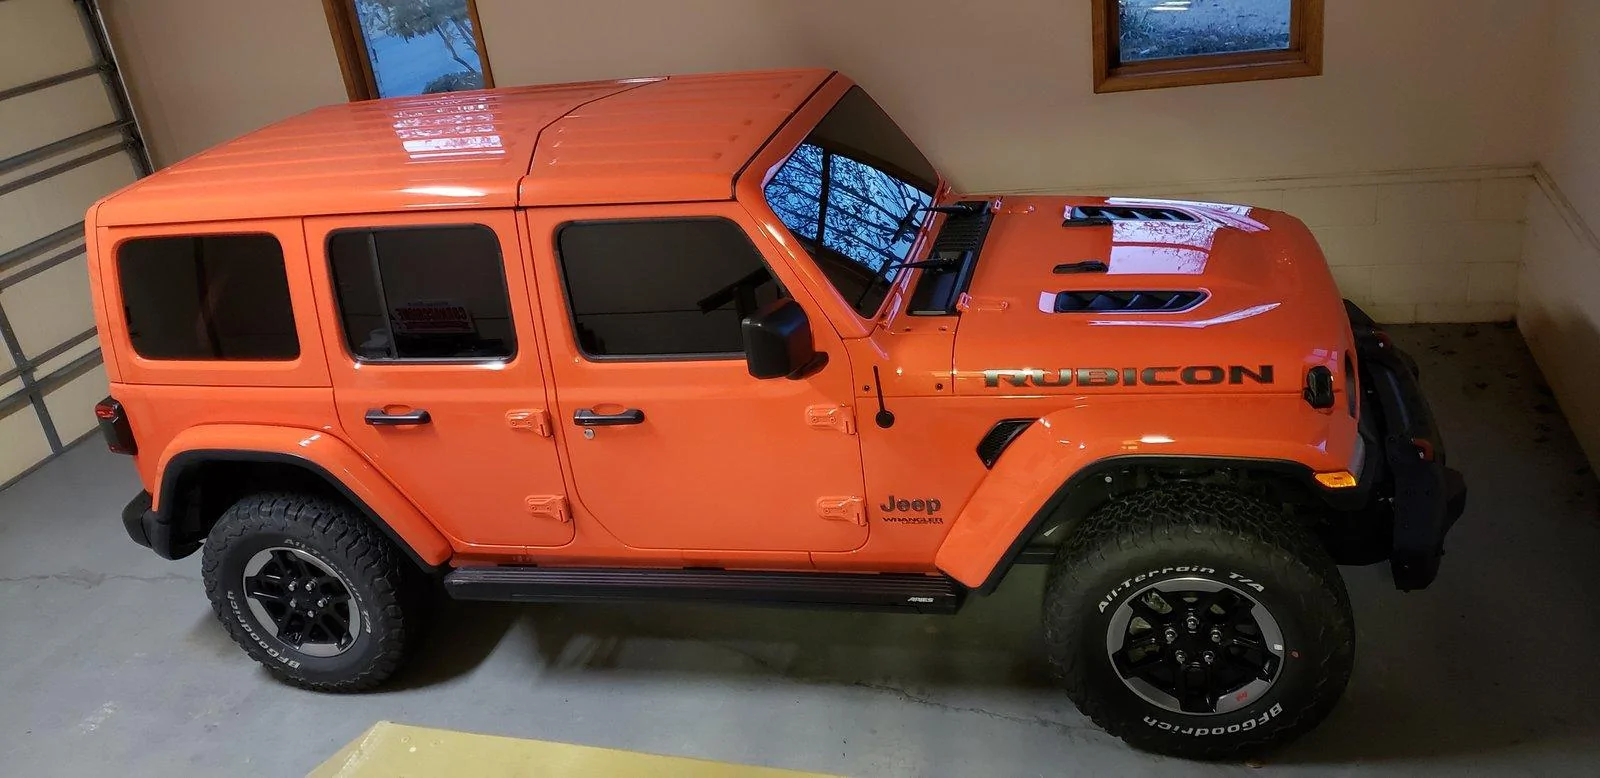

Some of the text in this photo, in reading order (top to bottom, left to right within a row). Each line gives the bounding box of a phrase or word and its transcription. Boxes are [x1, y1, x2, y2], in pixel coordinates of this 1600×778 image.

[984, 364, 1275, 388] RUBICON
[880, 495, 942, 515] Jeep
[1098, 565, 1265, 614] All-Terrain T/A
[226, 590, 301, 669] BFGoodrich
[1142, 702, 1284, 737] BFGoodrich
